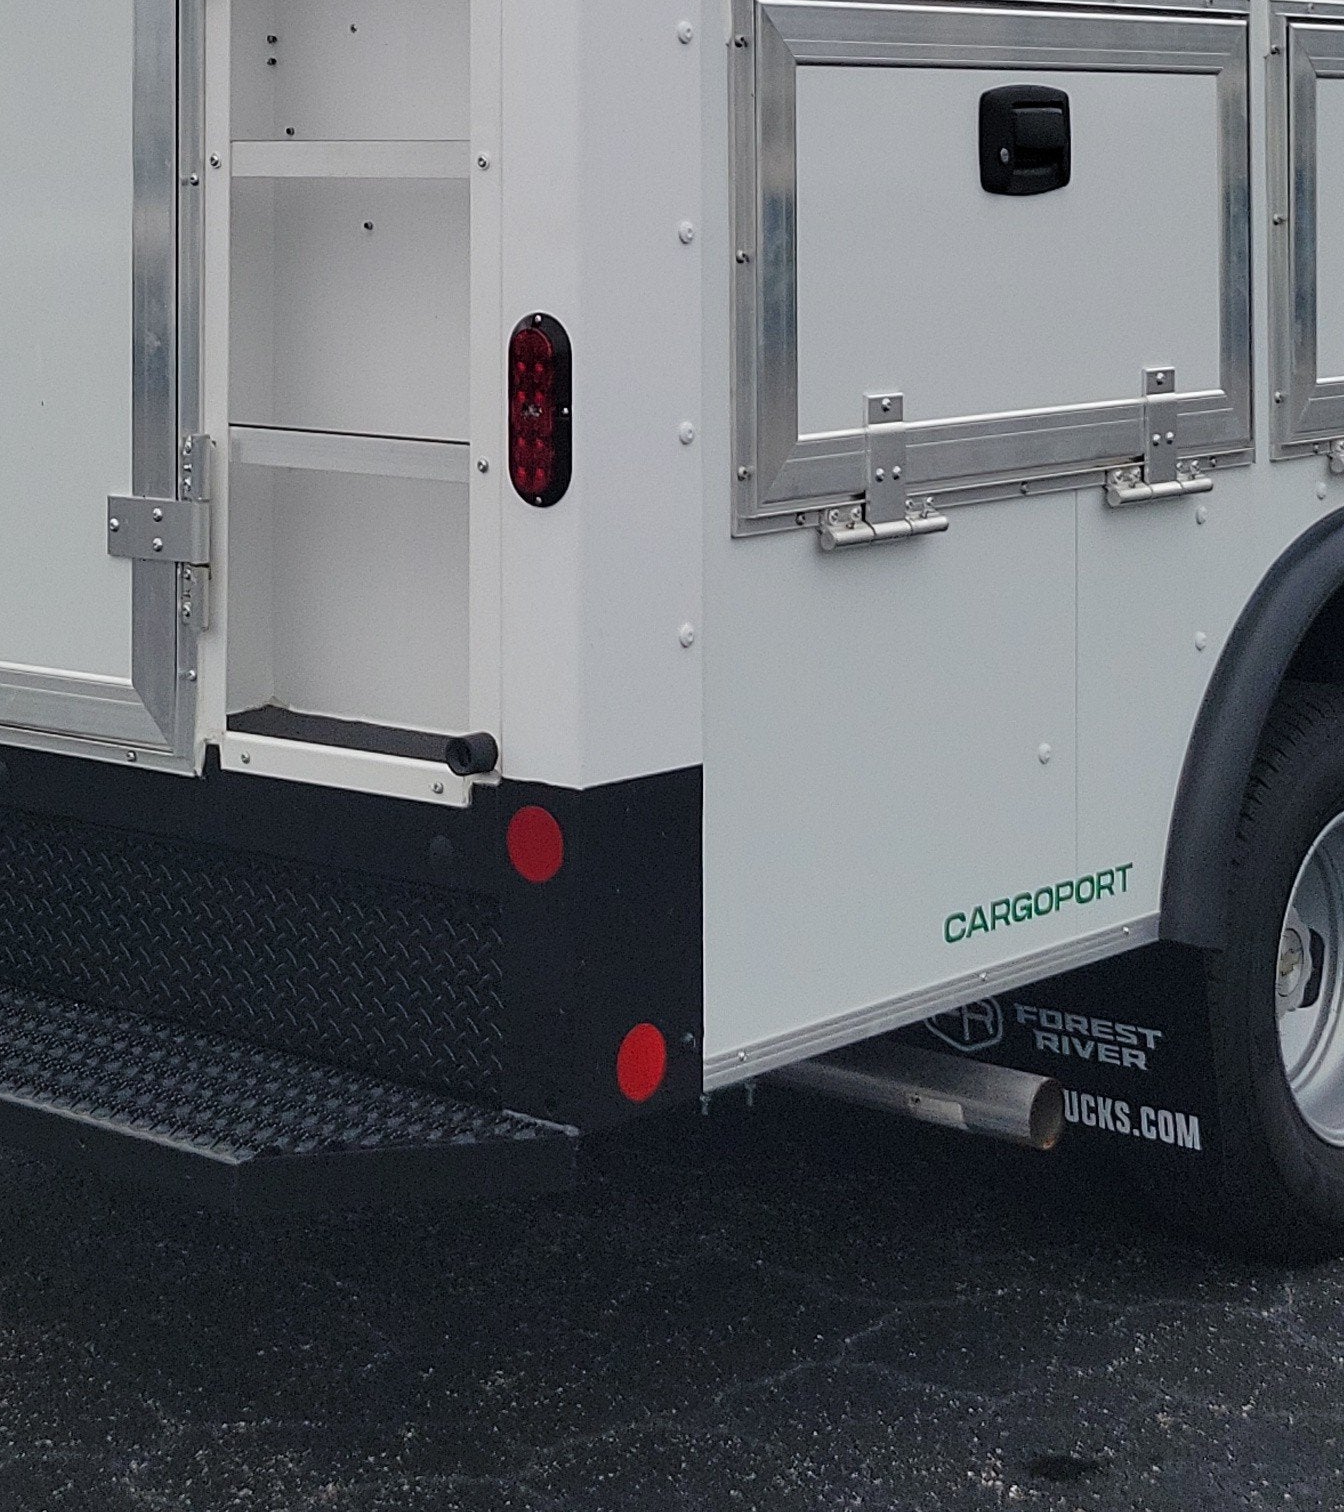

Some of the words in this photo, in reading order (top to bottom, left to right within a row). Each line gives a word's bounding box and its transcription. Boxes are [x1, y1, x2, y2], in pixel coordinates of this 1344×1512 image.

[943, 861, 1134, 944] CARGOPORT
[1013, 1002, 1164, 1050] FOREST
[1032, 1028, 1149, 1071] RIVER
[1062, 1088, 1203, 1151] UCKS.COM
